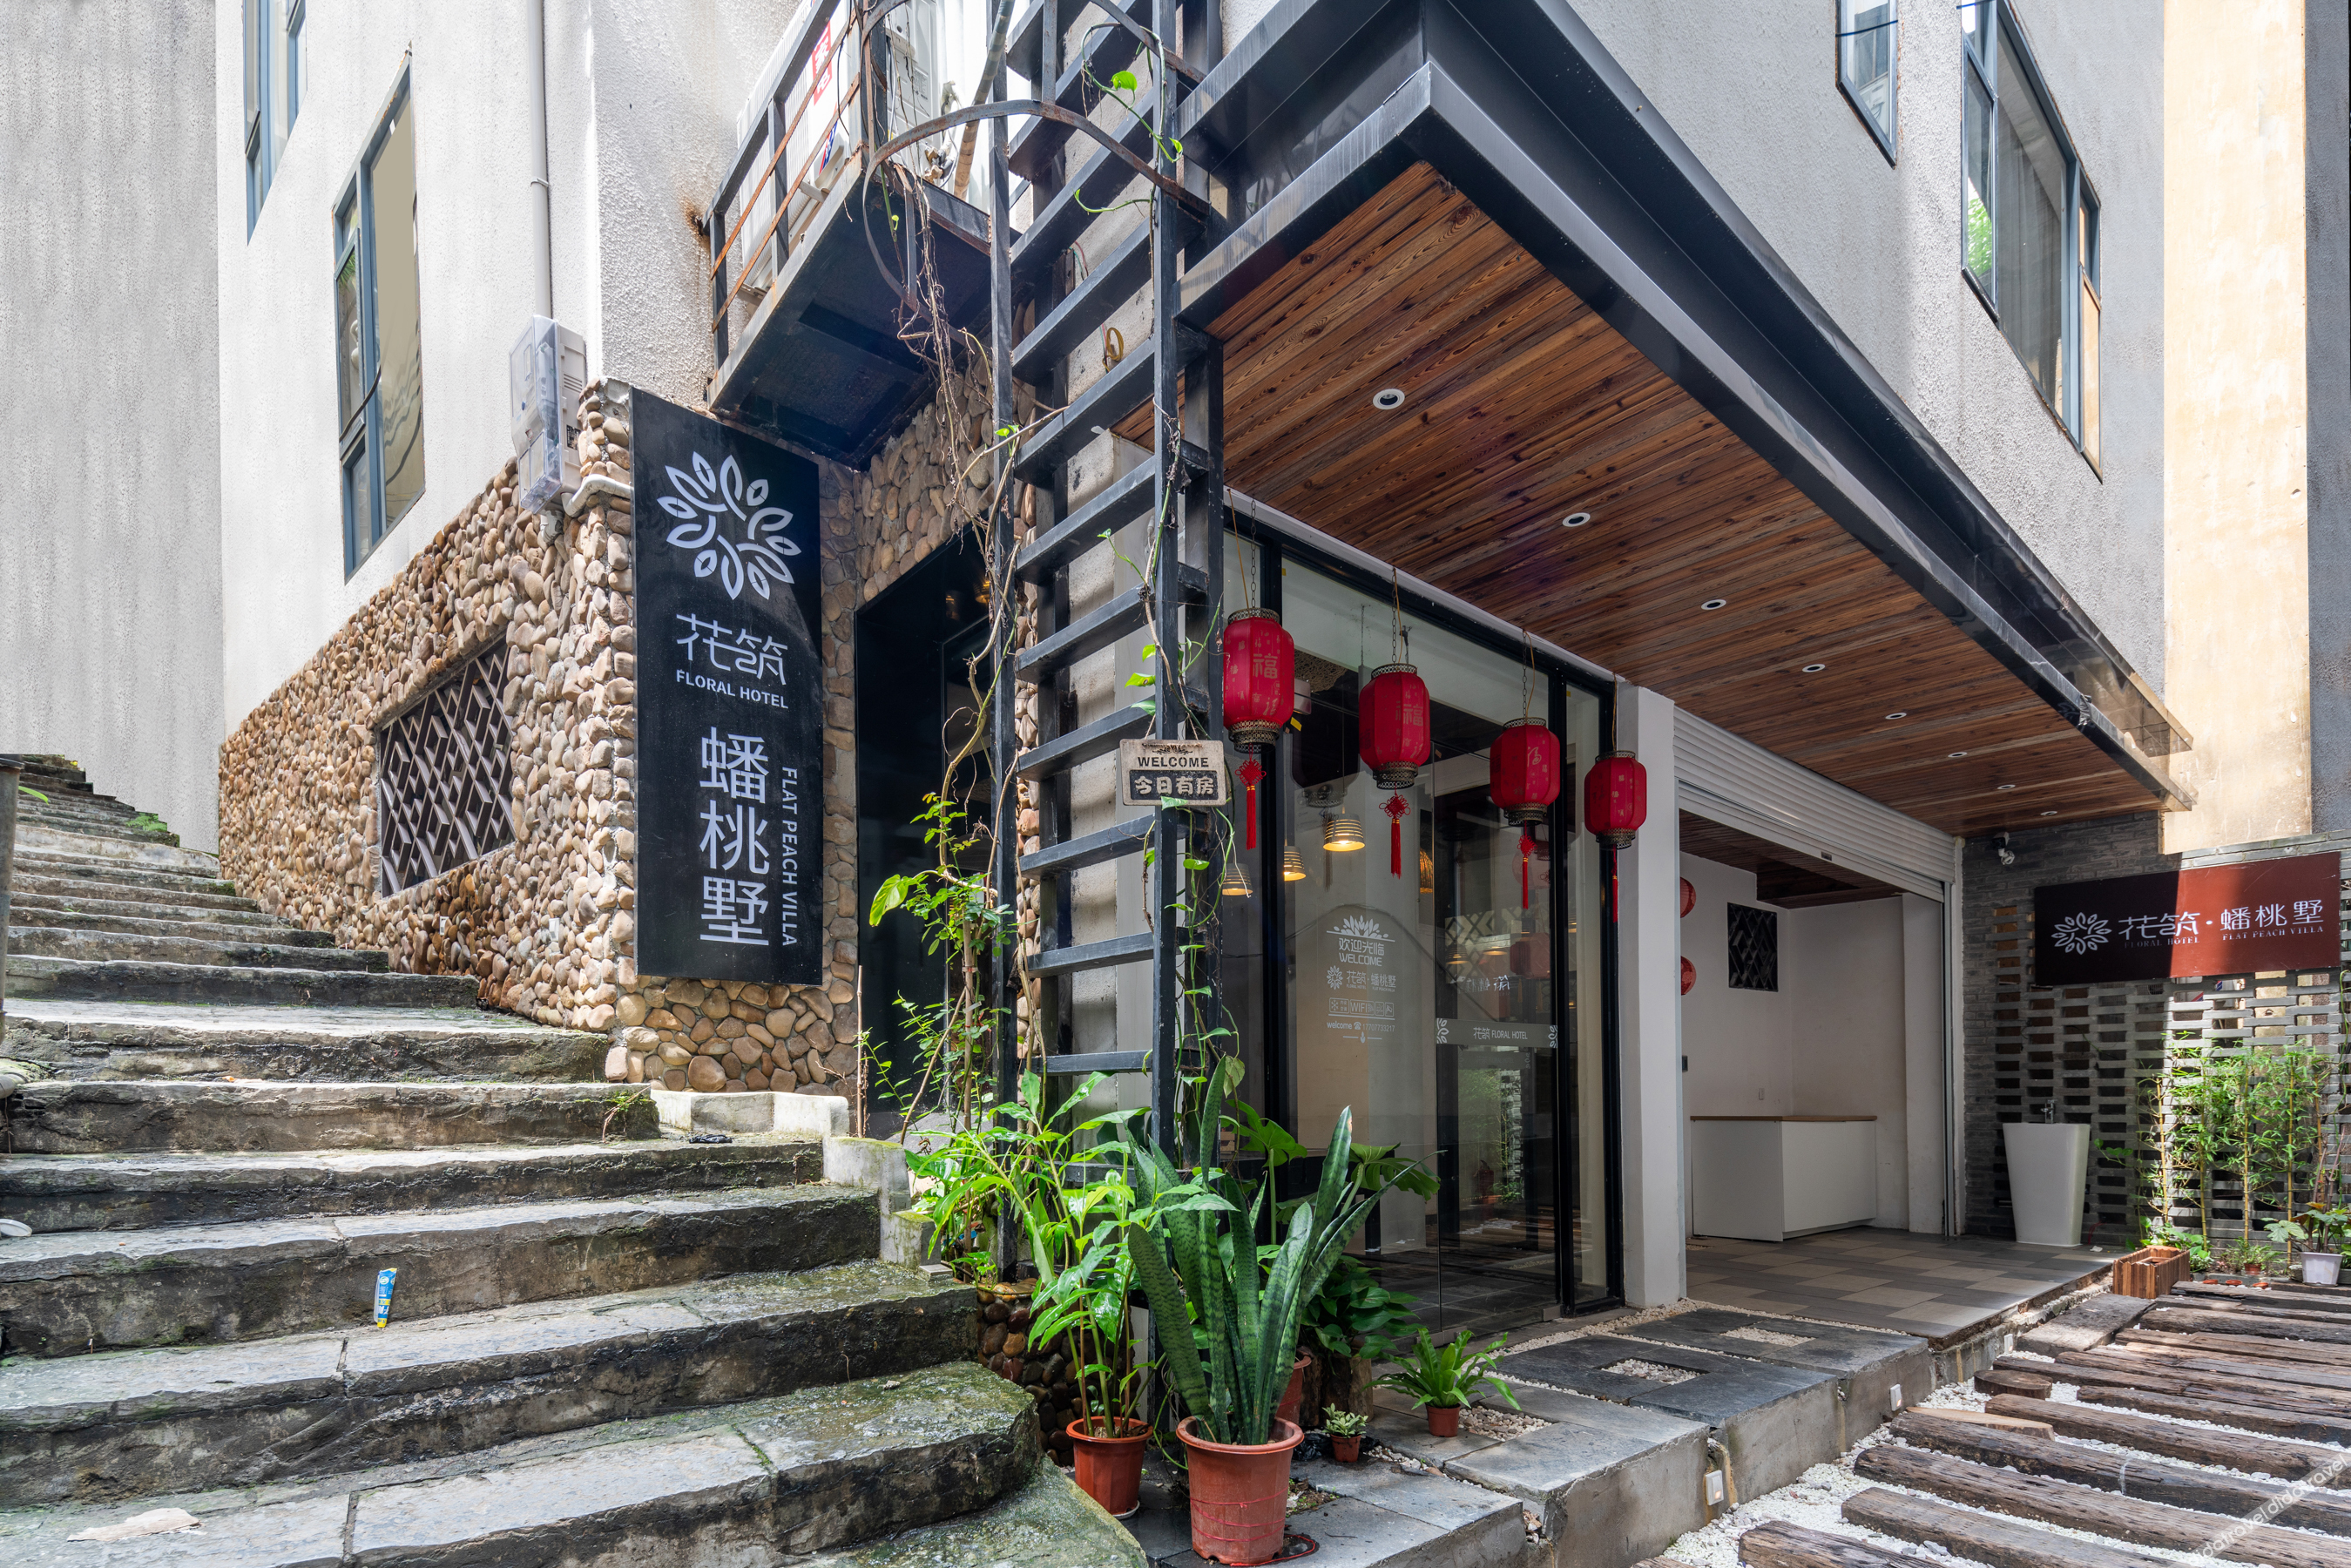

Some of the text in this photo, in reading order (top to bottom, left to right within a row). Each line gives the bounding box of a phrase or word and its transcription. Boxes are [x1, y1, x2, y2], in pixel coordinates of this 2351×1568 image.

[676, 613, 787, 685] 花筑
[1253, 652, 1278, 679] 福
[676, 669, 788, 708] FLORAL HOTEL
[1403, 704, 1424, 727] 福
[1138, 756, 1209, 767] WELCOME
[1134, 775, 1214, 795] 今日有房
[699, 727, 769, 946] 蟠桃墅
[782, 767, 798, 946] FLAT PEACH VILLA
[2222, 926, 2324, 941] FLAT PEACH VILLA
[1339, 938, 1385, 956] 欢迎光临
[2124, 936, 2200, 949] FLORAL HOTEL
[1339, 952, 1382, 966] WELCOME
[1350, 1003, 1368, 1013] WIFI
[1327, 1021, 1352, 1030] welcome
[1473, 1027, 1490, 1040] 花筑
[1491, 1030, 1528, 1040] FLORAL HOTEL
